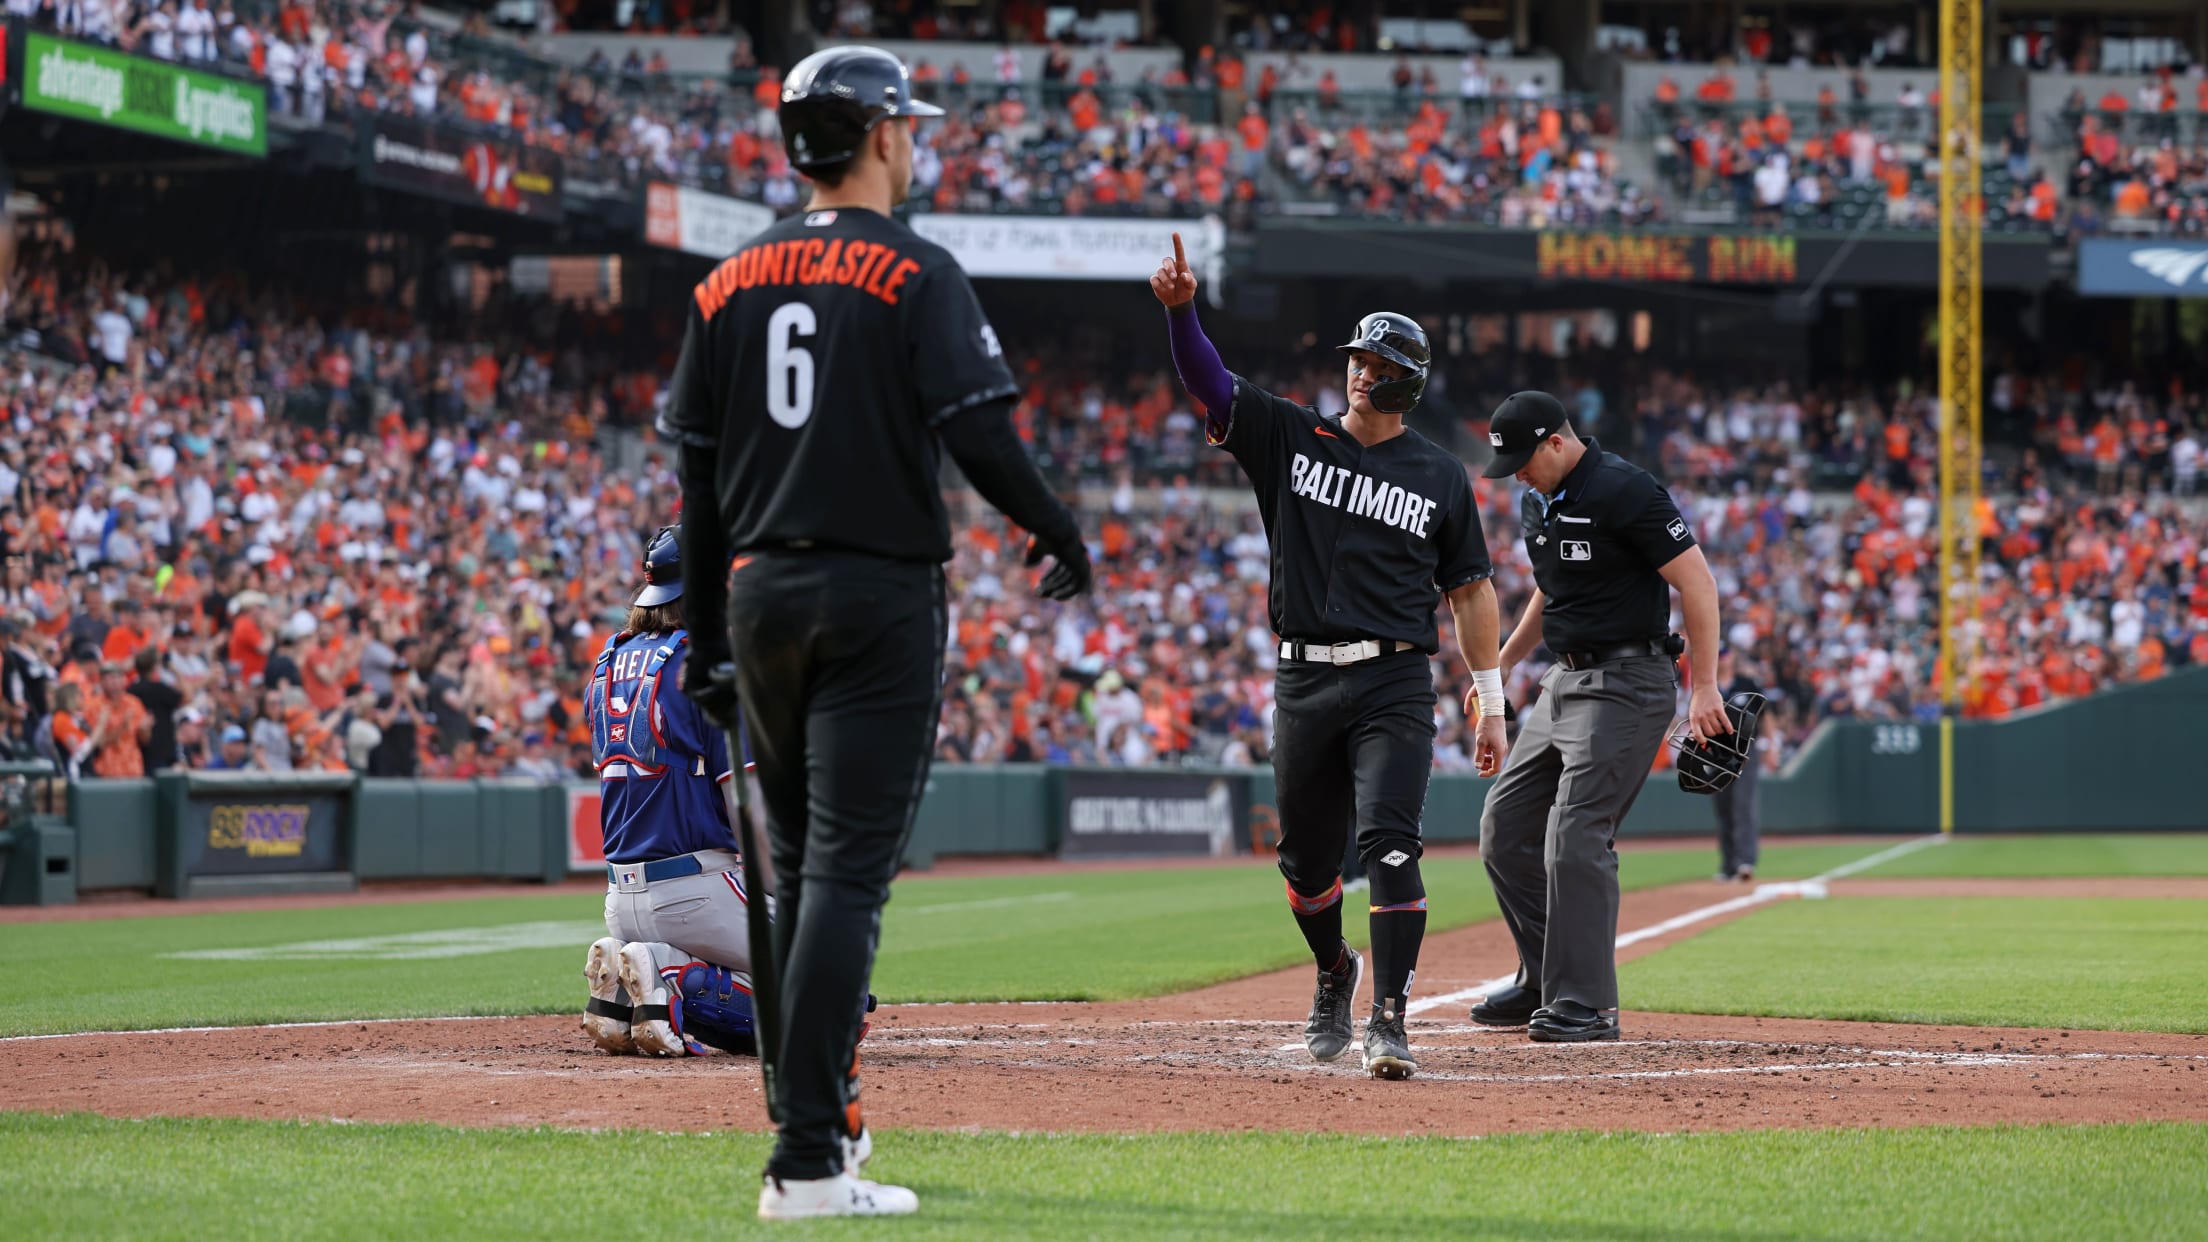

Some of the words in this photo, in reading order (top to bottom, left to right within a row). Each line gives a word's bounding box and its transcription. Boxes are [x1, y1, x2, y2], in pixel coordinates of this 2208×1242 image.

[694, 238, 921, 322] MOUNTCASTLE
[1537, 232, 1695, 281] HOME
[1708, 233, 1797, 283] RUN
[1366, 319, 1390, 341] B
[766, 302, 817, 430] 6
[1291, 452, 1437, 540] BALTIMORE
[612, 649, 657, 682] HEI
[1872, 724, 1920, 754] 333
